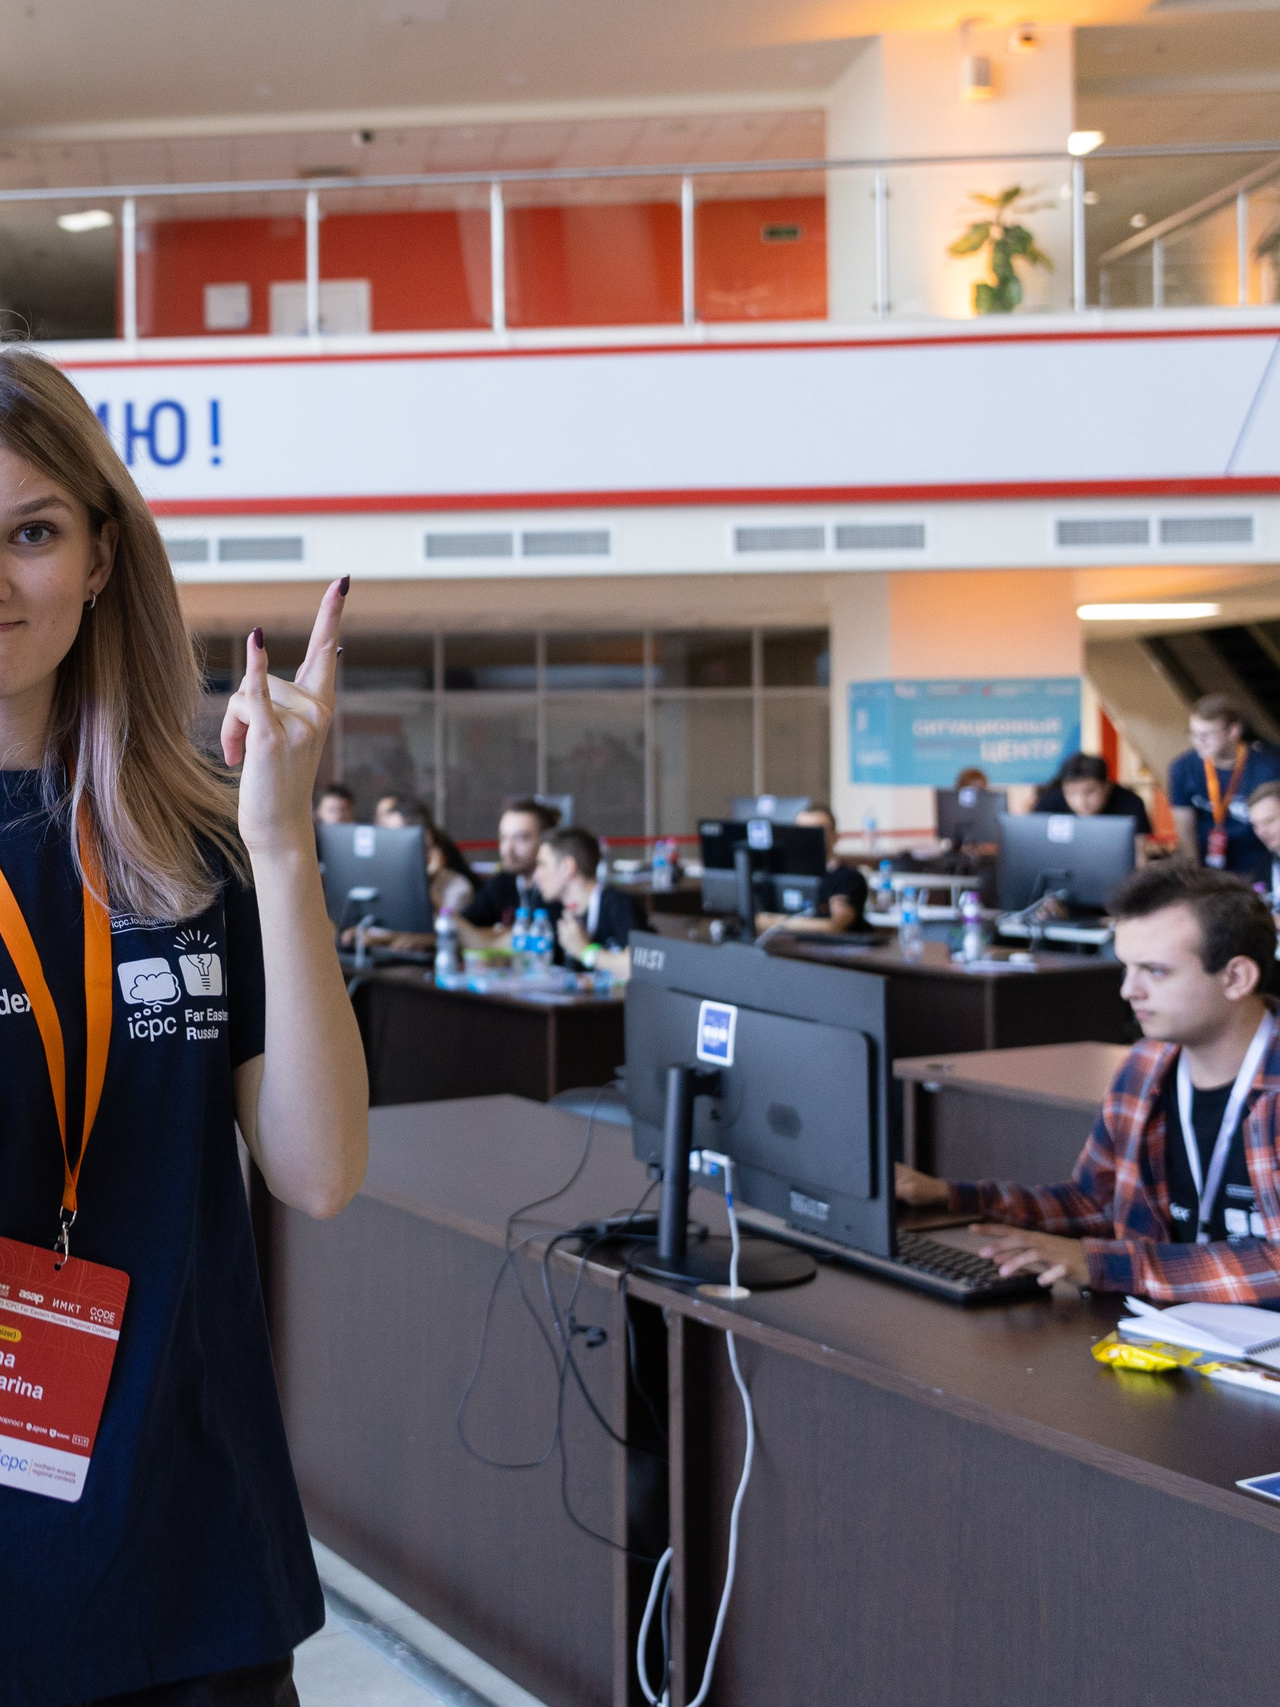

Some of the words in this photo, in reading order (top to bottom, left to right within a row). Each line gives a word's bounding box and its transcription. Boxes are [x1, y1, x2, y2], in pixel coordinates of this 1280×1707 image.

[184, 1008, 204, 1022] Far
[127, 1016, 177, 1042] icpc
[186, 1026, 219, 1040] Russia
[52, 1298, 81, 1314] ИМКТ
[90, 1307, 115, 1321] CODE
